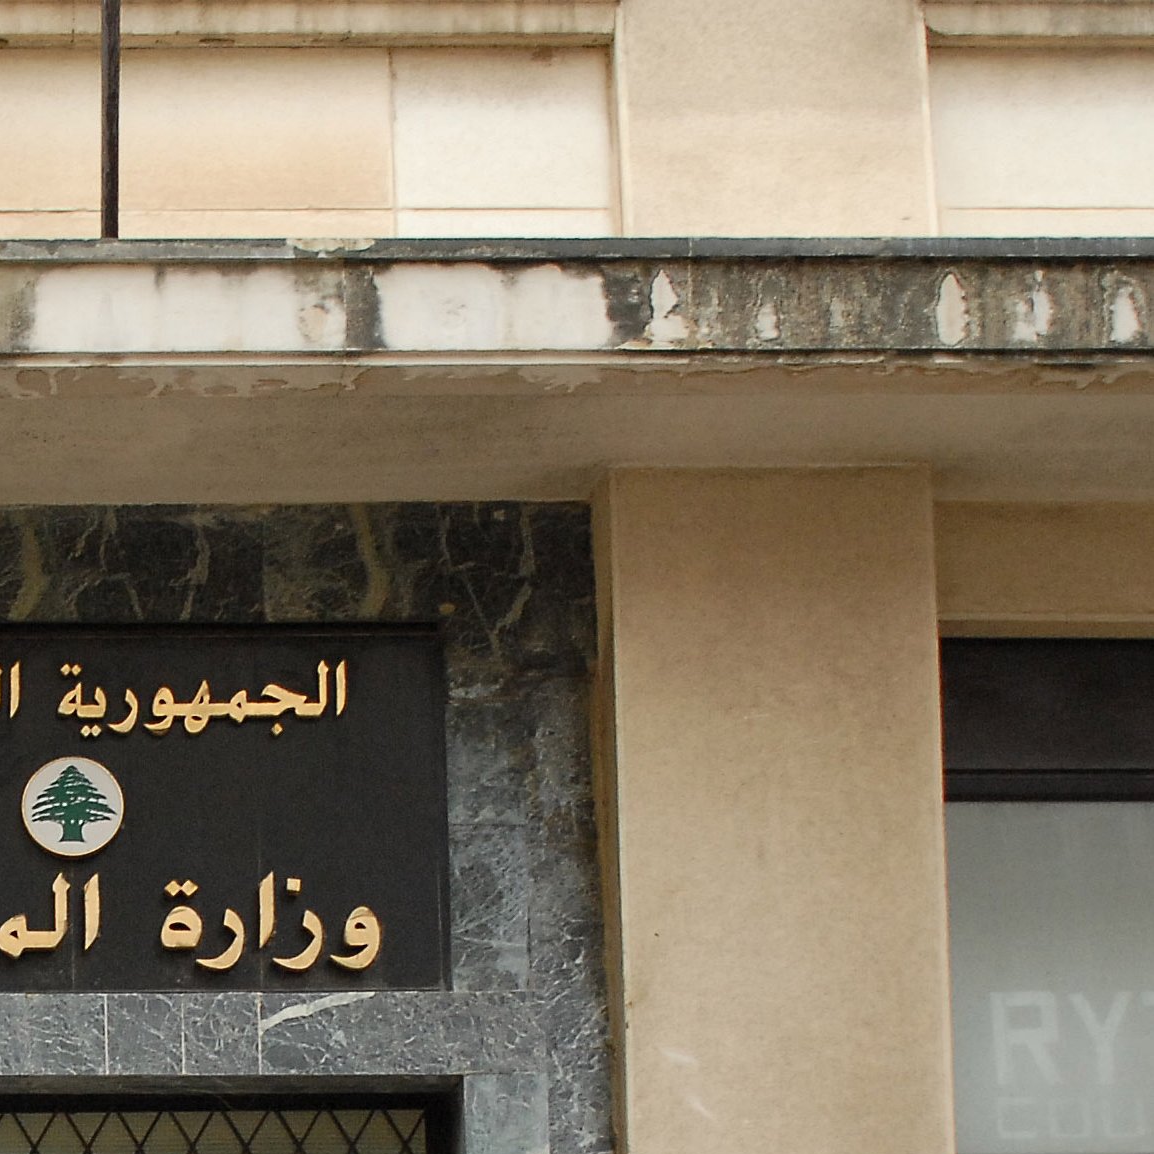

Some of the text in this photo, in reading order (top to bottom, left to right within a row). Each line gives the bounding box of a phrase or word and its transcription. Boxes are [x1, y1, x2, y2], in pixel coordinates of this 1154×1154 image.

[57, 659, 347, 738] الجمهورية
[160, 870, 382, 972] وزارة
[990, 990, 1154, 1085] RY
